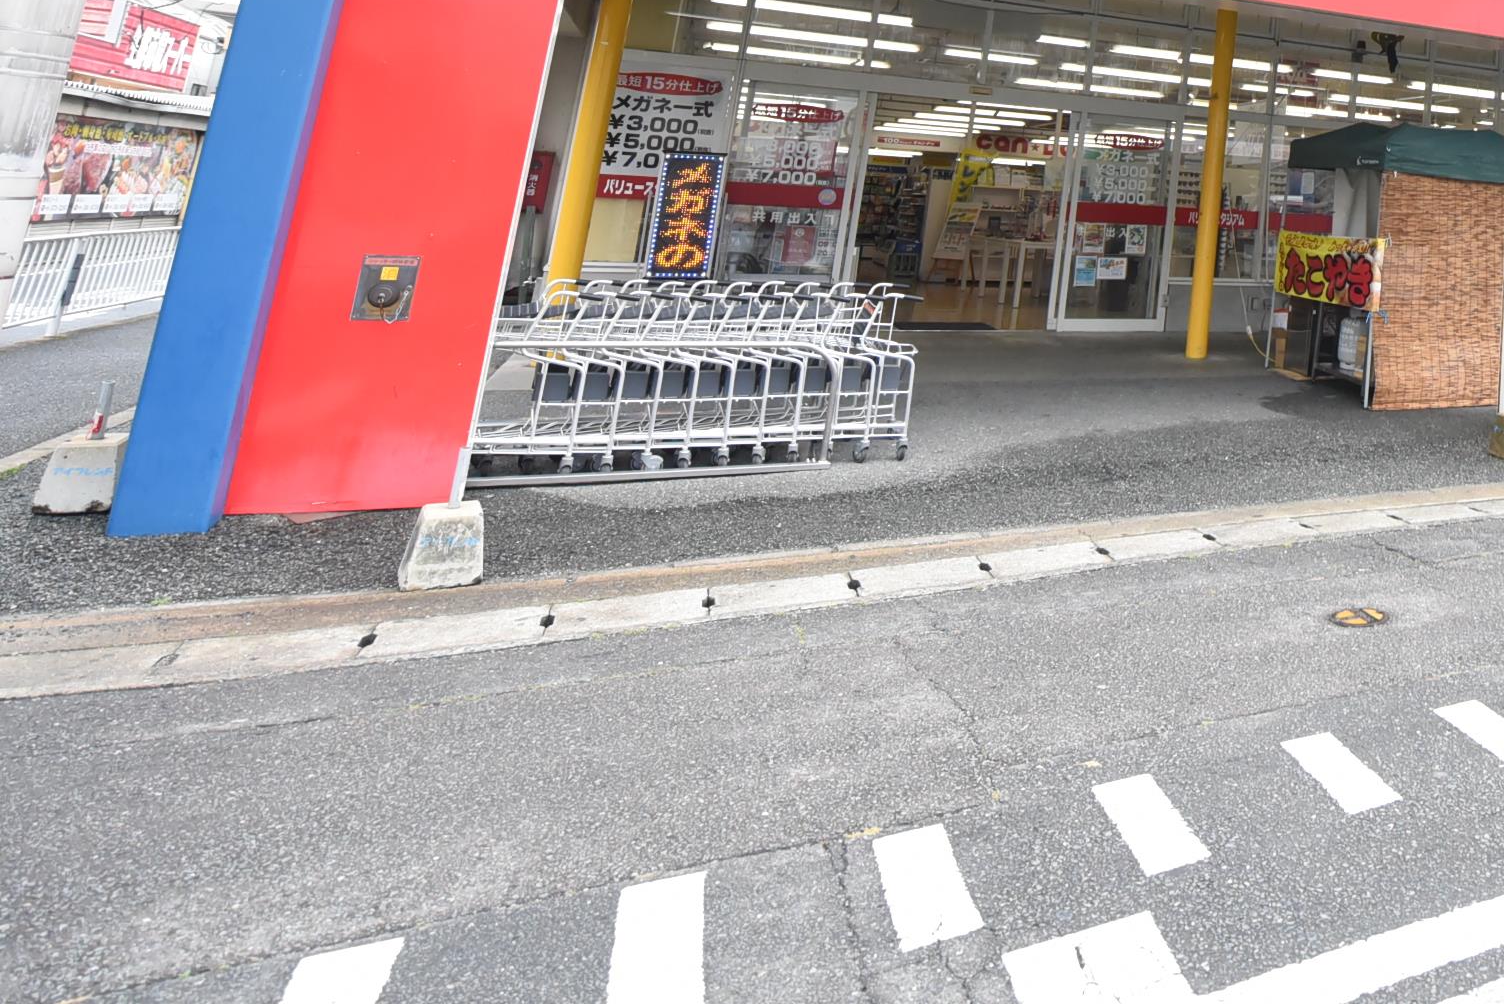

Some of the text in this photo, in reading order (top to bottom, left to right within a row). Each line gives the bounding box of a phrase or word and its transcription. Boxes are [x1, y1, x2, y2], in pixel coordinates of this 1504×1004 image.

[616, 75, 720, 94] 最短15分仕上げ
[612, 94, 715, 118] メガネ一式
[608, 113, 699, 135] ¥3,000
[605, 132, 695, 152] ¥5,000
[601, 149, 660, 168] ¥7,0
[603, 178, 657, 197] バリュース
[653, 161, 714, 270] メガネの
[1284, 247, 1374, 307] たこやき
